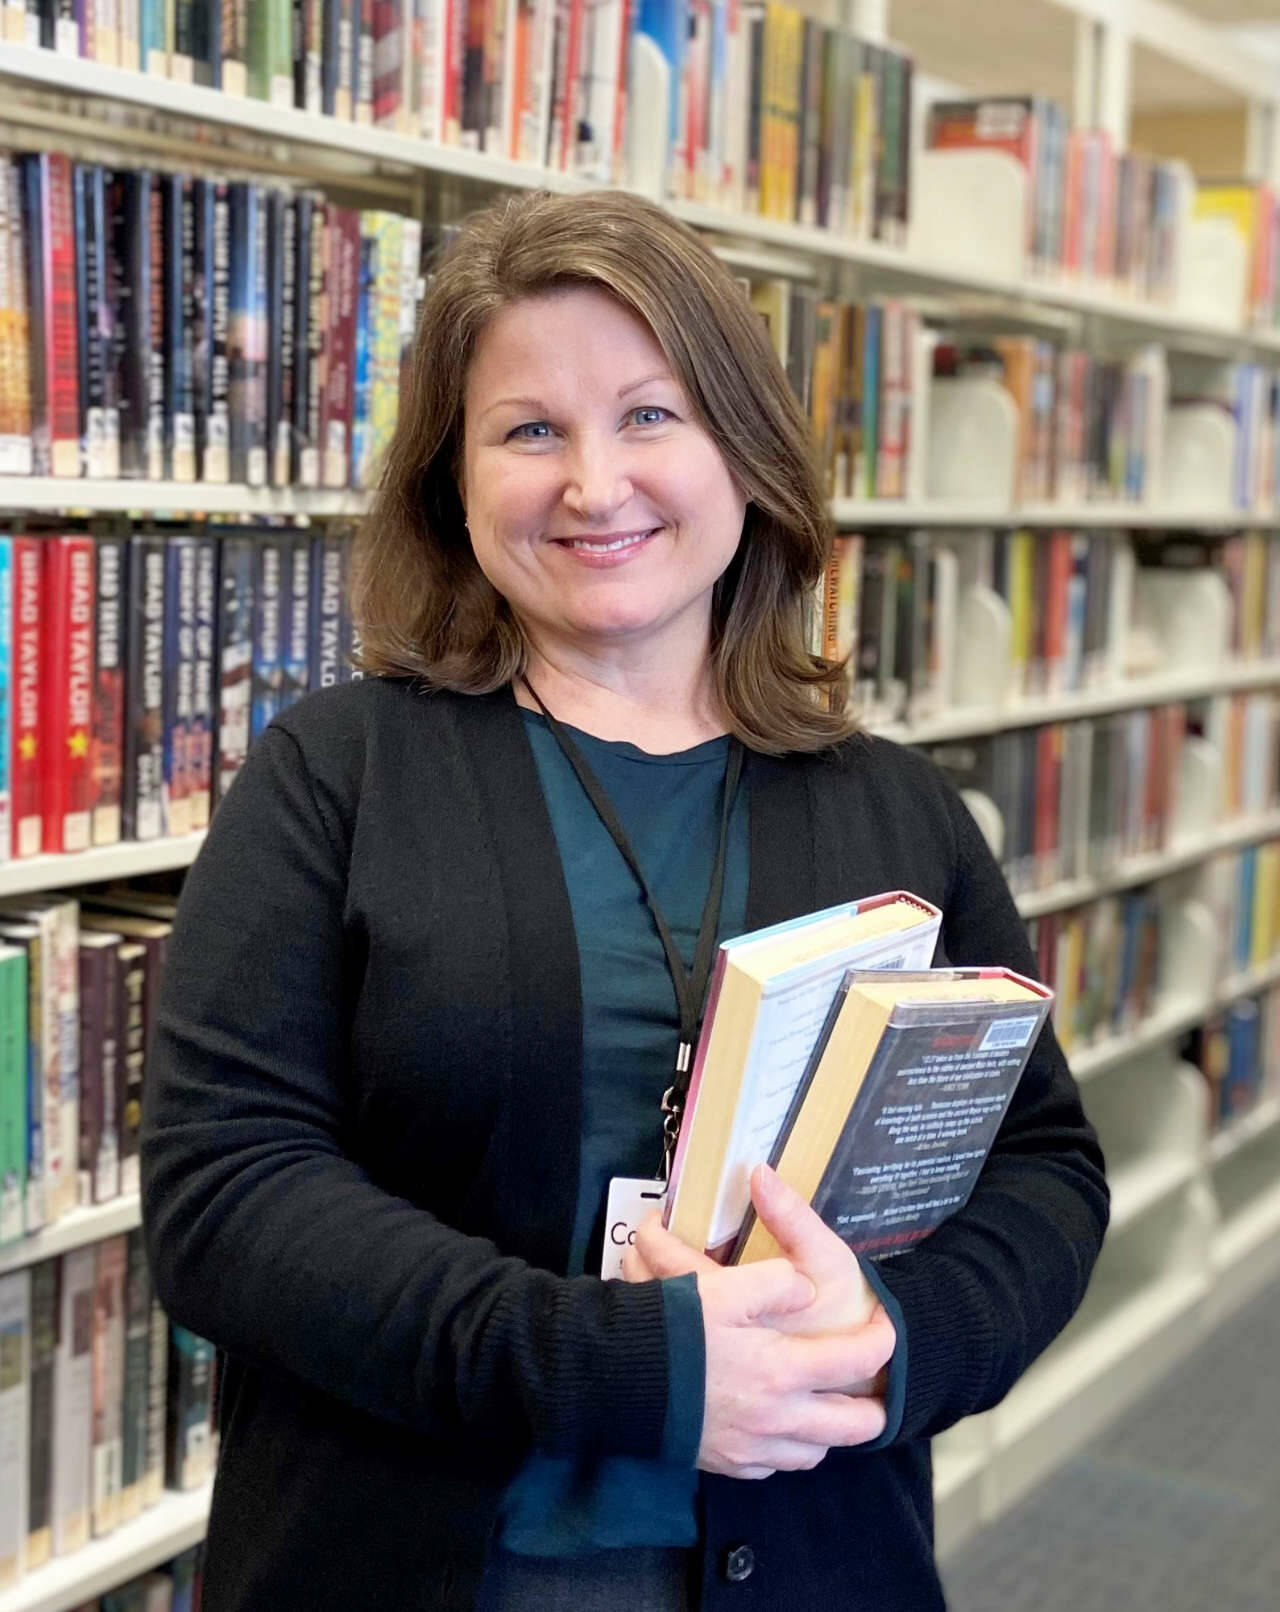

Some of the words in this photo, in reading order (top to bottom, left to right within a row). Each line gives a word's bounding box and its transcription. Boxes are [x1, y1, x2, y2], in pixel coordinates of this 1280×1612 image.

[21, 551, 38, 623] BRAD
[71, 551, 90, 623] BRAD
[145, 552, 163, 619] BRAD
[322, 551, 340, 615] BRAD
[19, 627, 38, 728] TAYLOR
[69, 625, 90, 725] TAYLOR
[144, 620, 163, 708] TAYLOR
